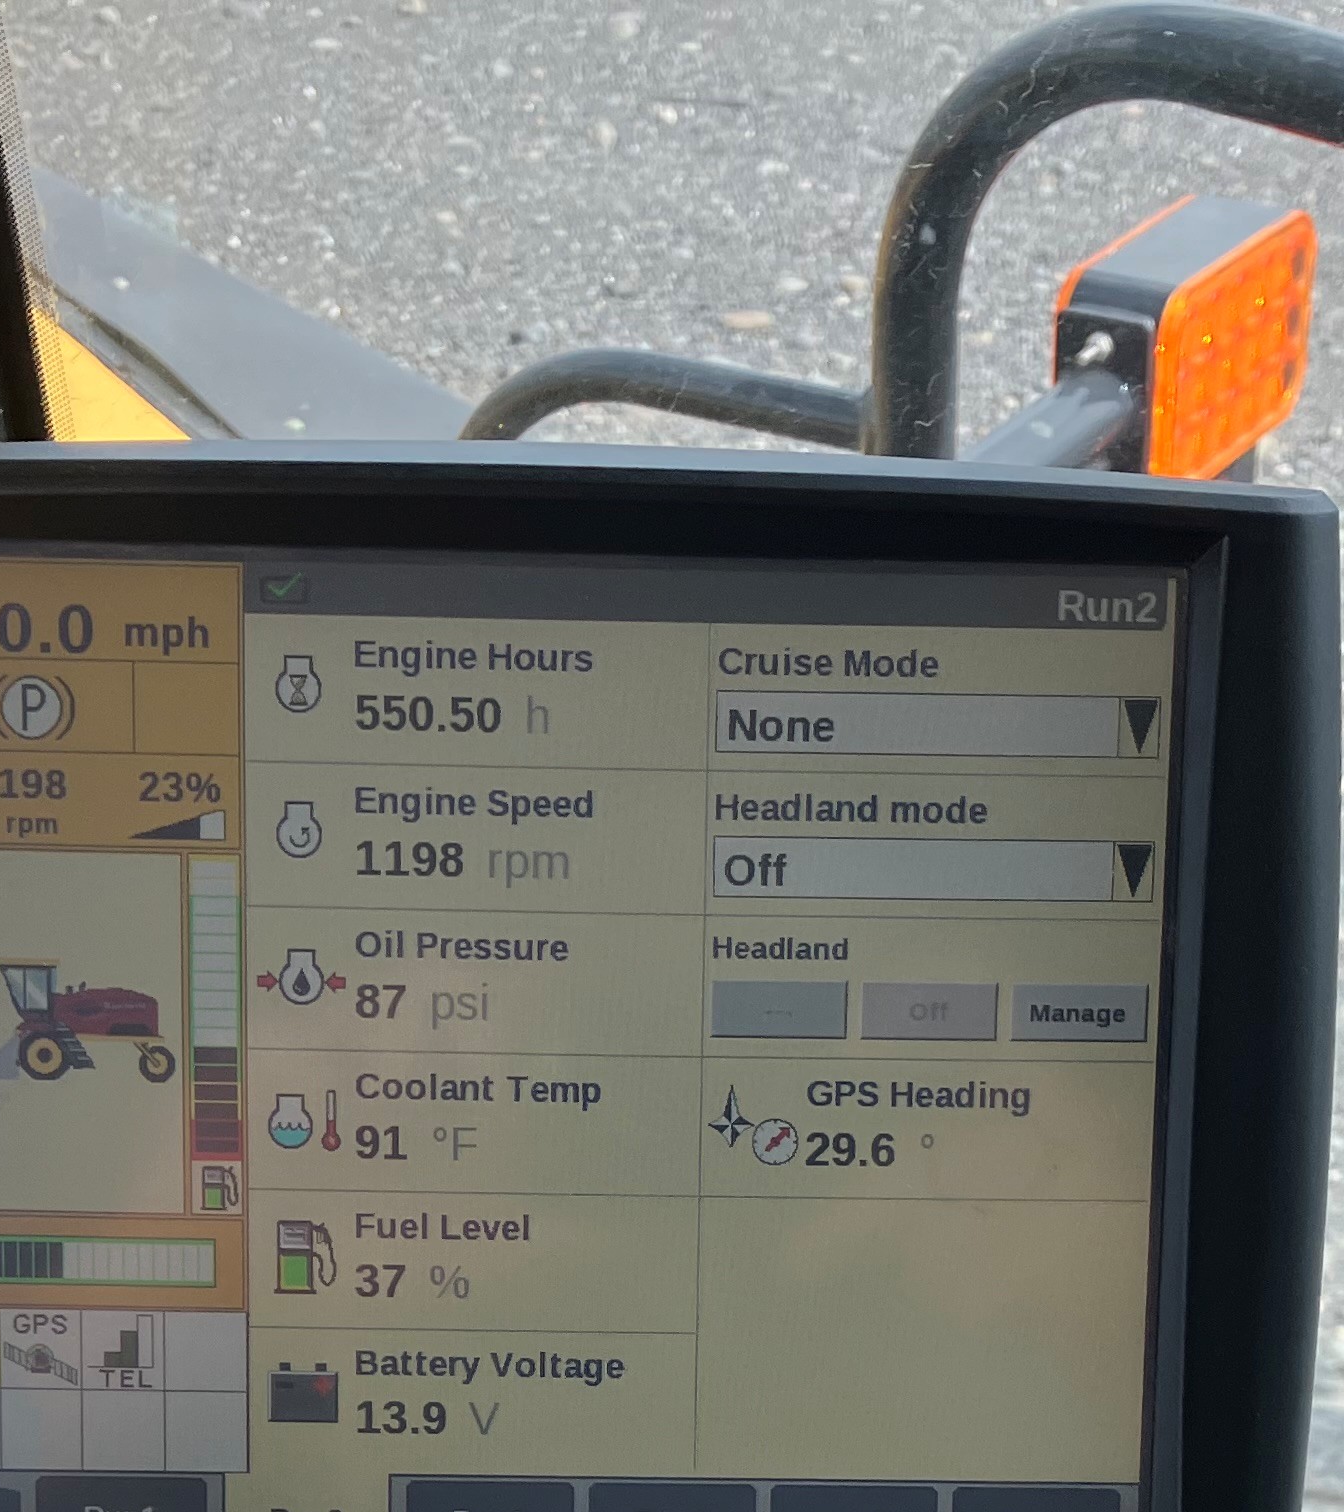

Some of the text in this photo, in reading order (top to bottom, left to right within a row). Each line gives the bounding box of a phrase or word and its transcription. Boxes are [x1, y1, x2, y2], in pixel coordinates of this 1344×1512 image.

[1056, 590, 1158, 624] Run2
[123, 616, 210, 655] mph
[354, 640, 594, 676] Engine Hours
[718, 647, 940, 679] Cruise Mode
[355, 695, 550, 734] 550.50 h
[727, 708, 835, 742] None
[138, 771, 221, 803] 23%
[354, 786, 594, 825] Engine Speed
[714, 794, 989, 825] Headland mode
[5, 816, 60, 838] rpm
[356, 840, 570, 888] 1198 rpm
[724, 853, 787, 887] Off
[355, 931, 569, 961] Oil Pressure
[712, 935, 849, 961] Headland
[355, 982, 489, 1030] 87 psi
[909, 1002, 949, 1023] Off
[1029, 1003, 1126, 1028] Manage
[355, 1073, 602, 1111] Coolant Temp
[806, 1080, 1031, 1117] GPS Heading
[355, 1126, 478, 1161] 91 °F
[805, 1133, 896, 1168] 29.6
[355, 1212, 530, 1241] Fuel Level
[354, 1264, 470, 1299] 37 %
[13, 1314, 68, 1335] GPS
[98, 1369, 153, 1389] TEL
[356, 1349, 626, 1387] Battery Voltage
[356, 1400, 500, 1436] 13.9 V
